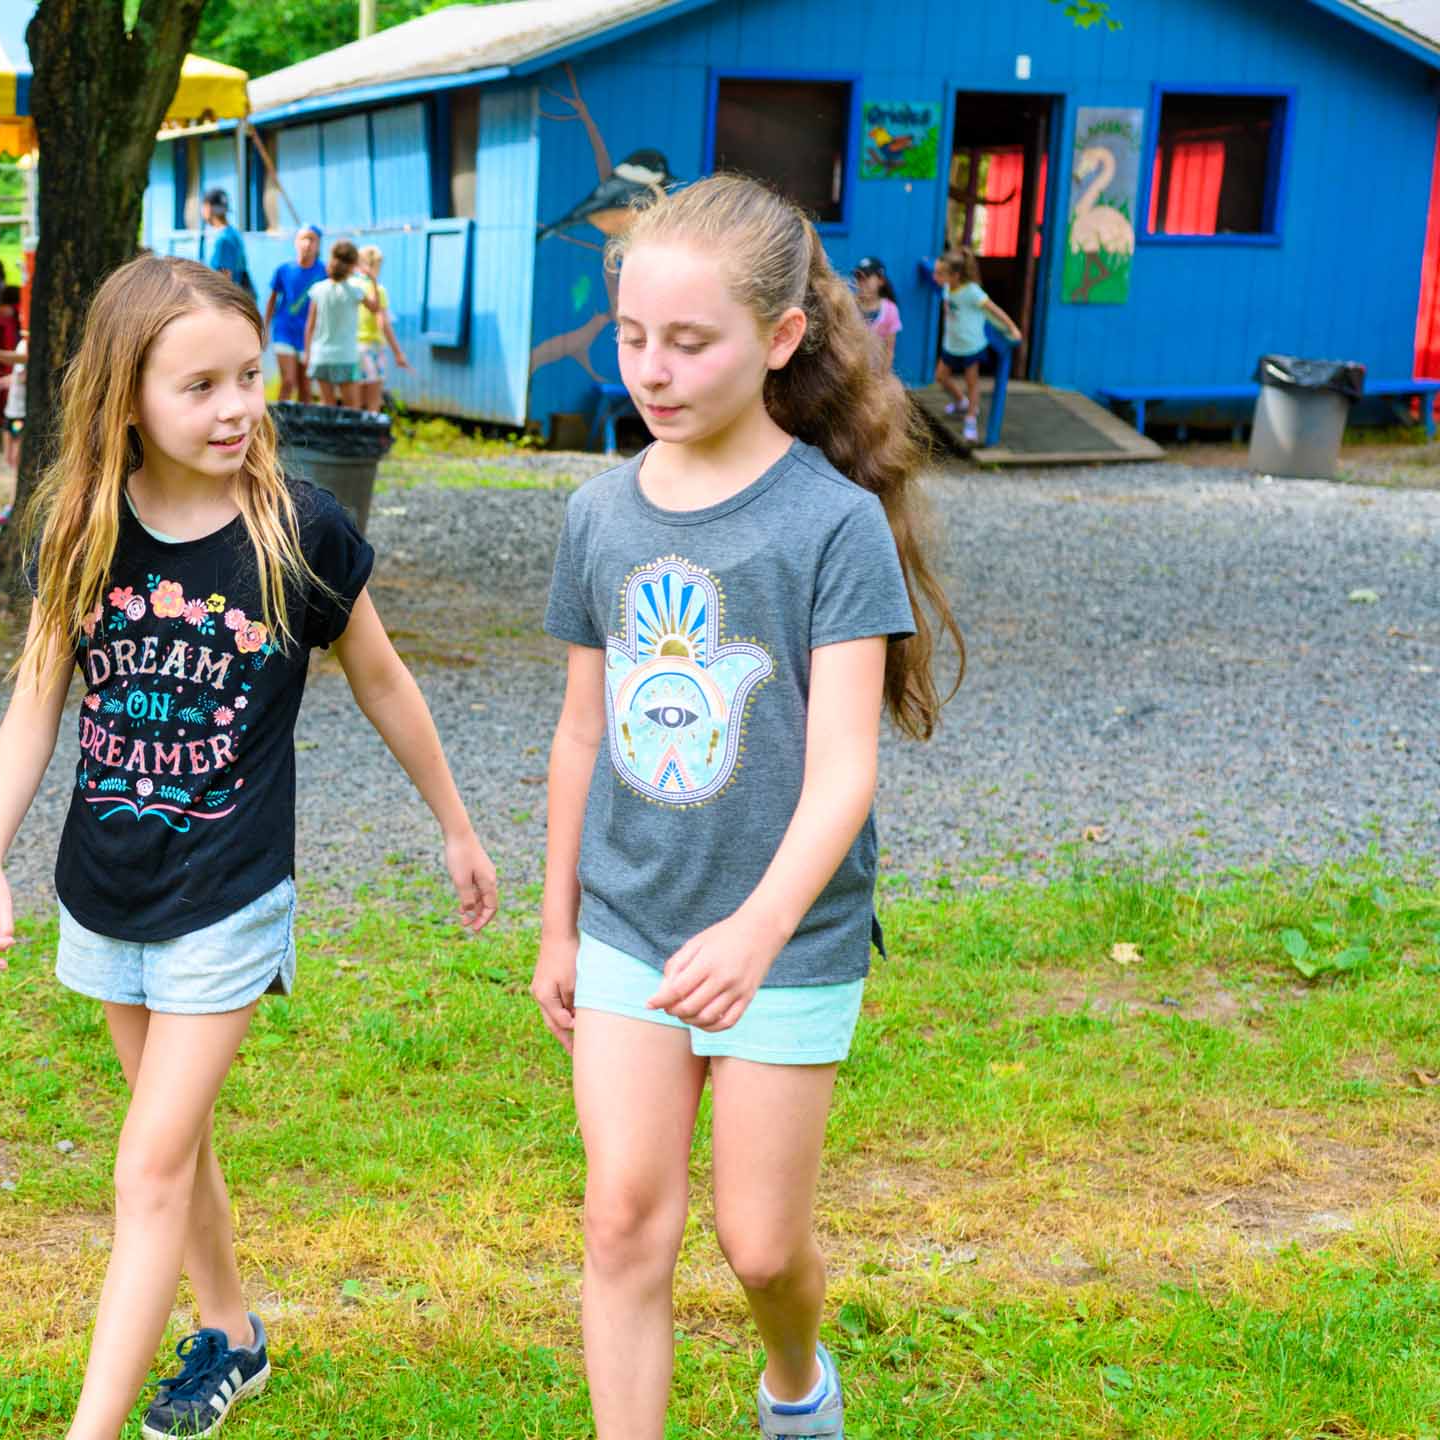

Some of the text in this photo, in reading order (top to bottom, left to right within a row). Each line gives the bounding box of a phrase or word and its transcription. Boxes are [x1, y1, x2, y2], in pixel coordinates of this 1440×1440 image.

[88, 636, 234, 690] DREAM
[126, 690, 172, 722] ON
[80, 717, 239, 776] DREAMER
